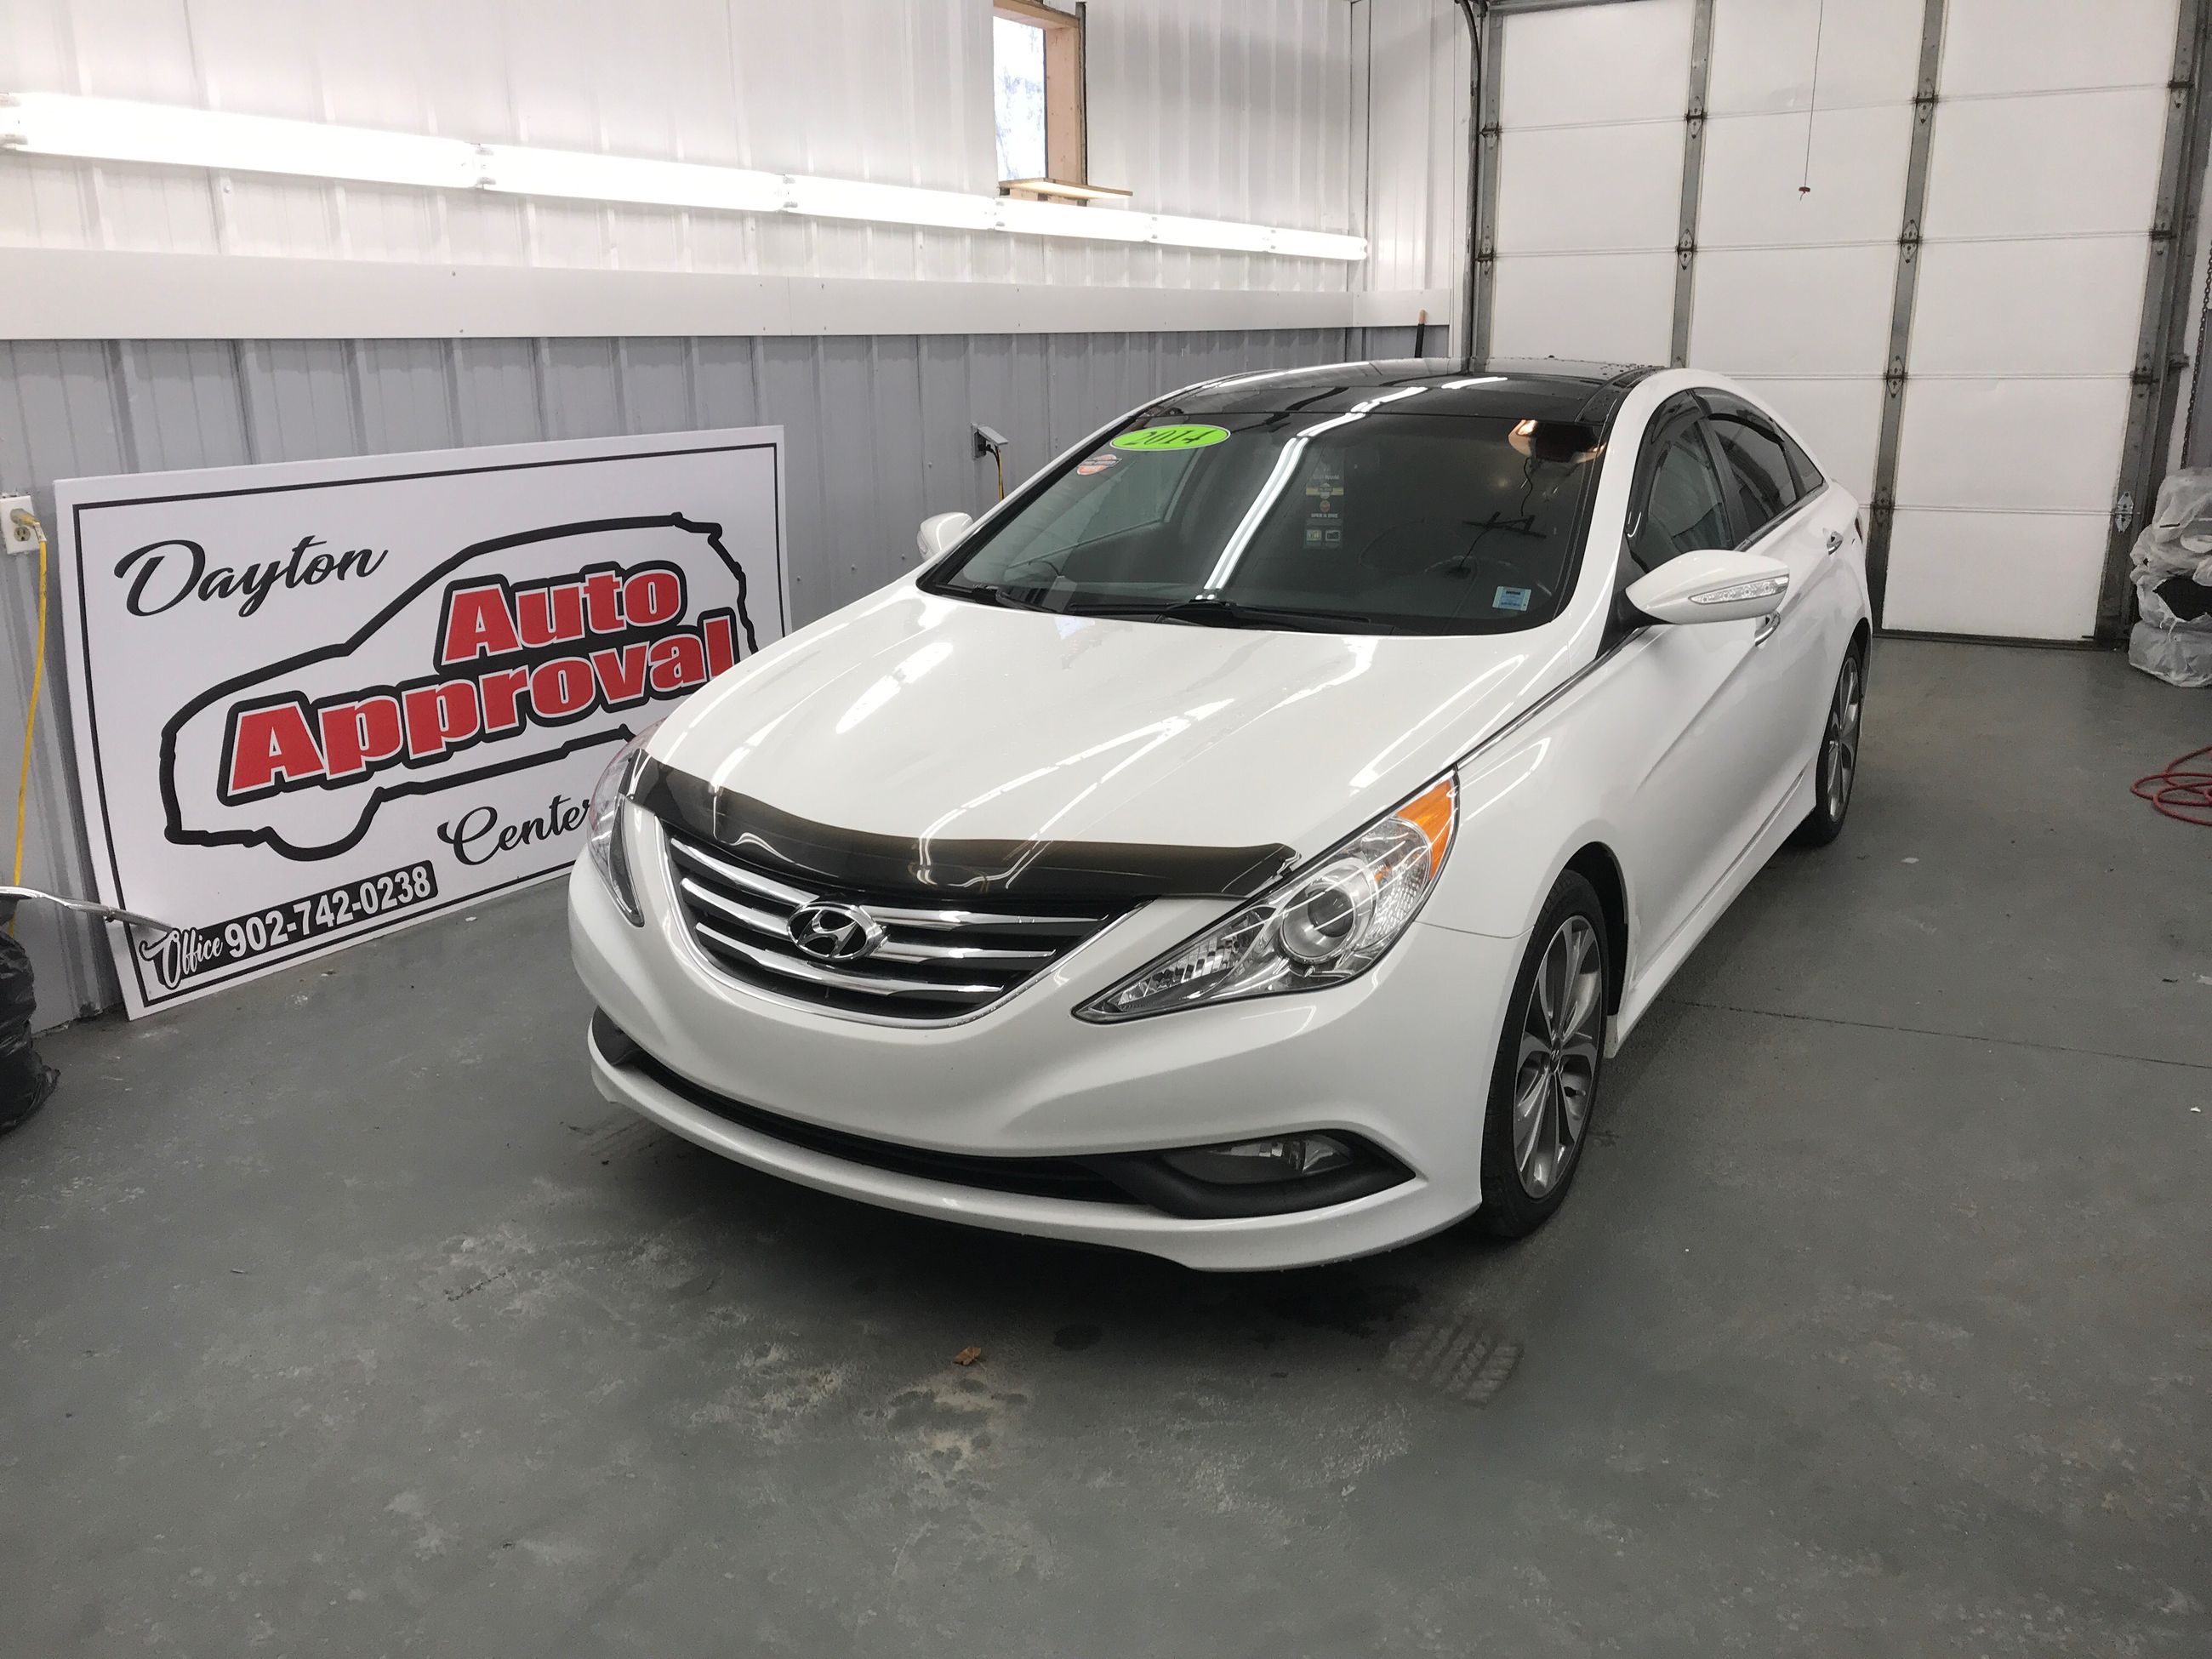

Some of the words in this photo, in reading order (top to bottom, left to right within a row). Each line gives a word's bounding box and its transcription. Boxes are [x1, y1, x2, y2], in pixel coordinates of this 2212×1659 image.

[1122, 430, 1217, 446] 2014
[114, 535, 389, 617] Dayton
[440, 567, 681, 666] Auto
[226, 614, 735, 797] Approval
[140, 928, 225, 989] Office
[225, 865, 431, 959] 902-742-0238
